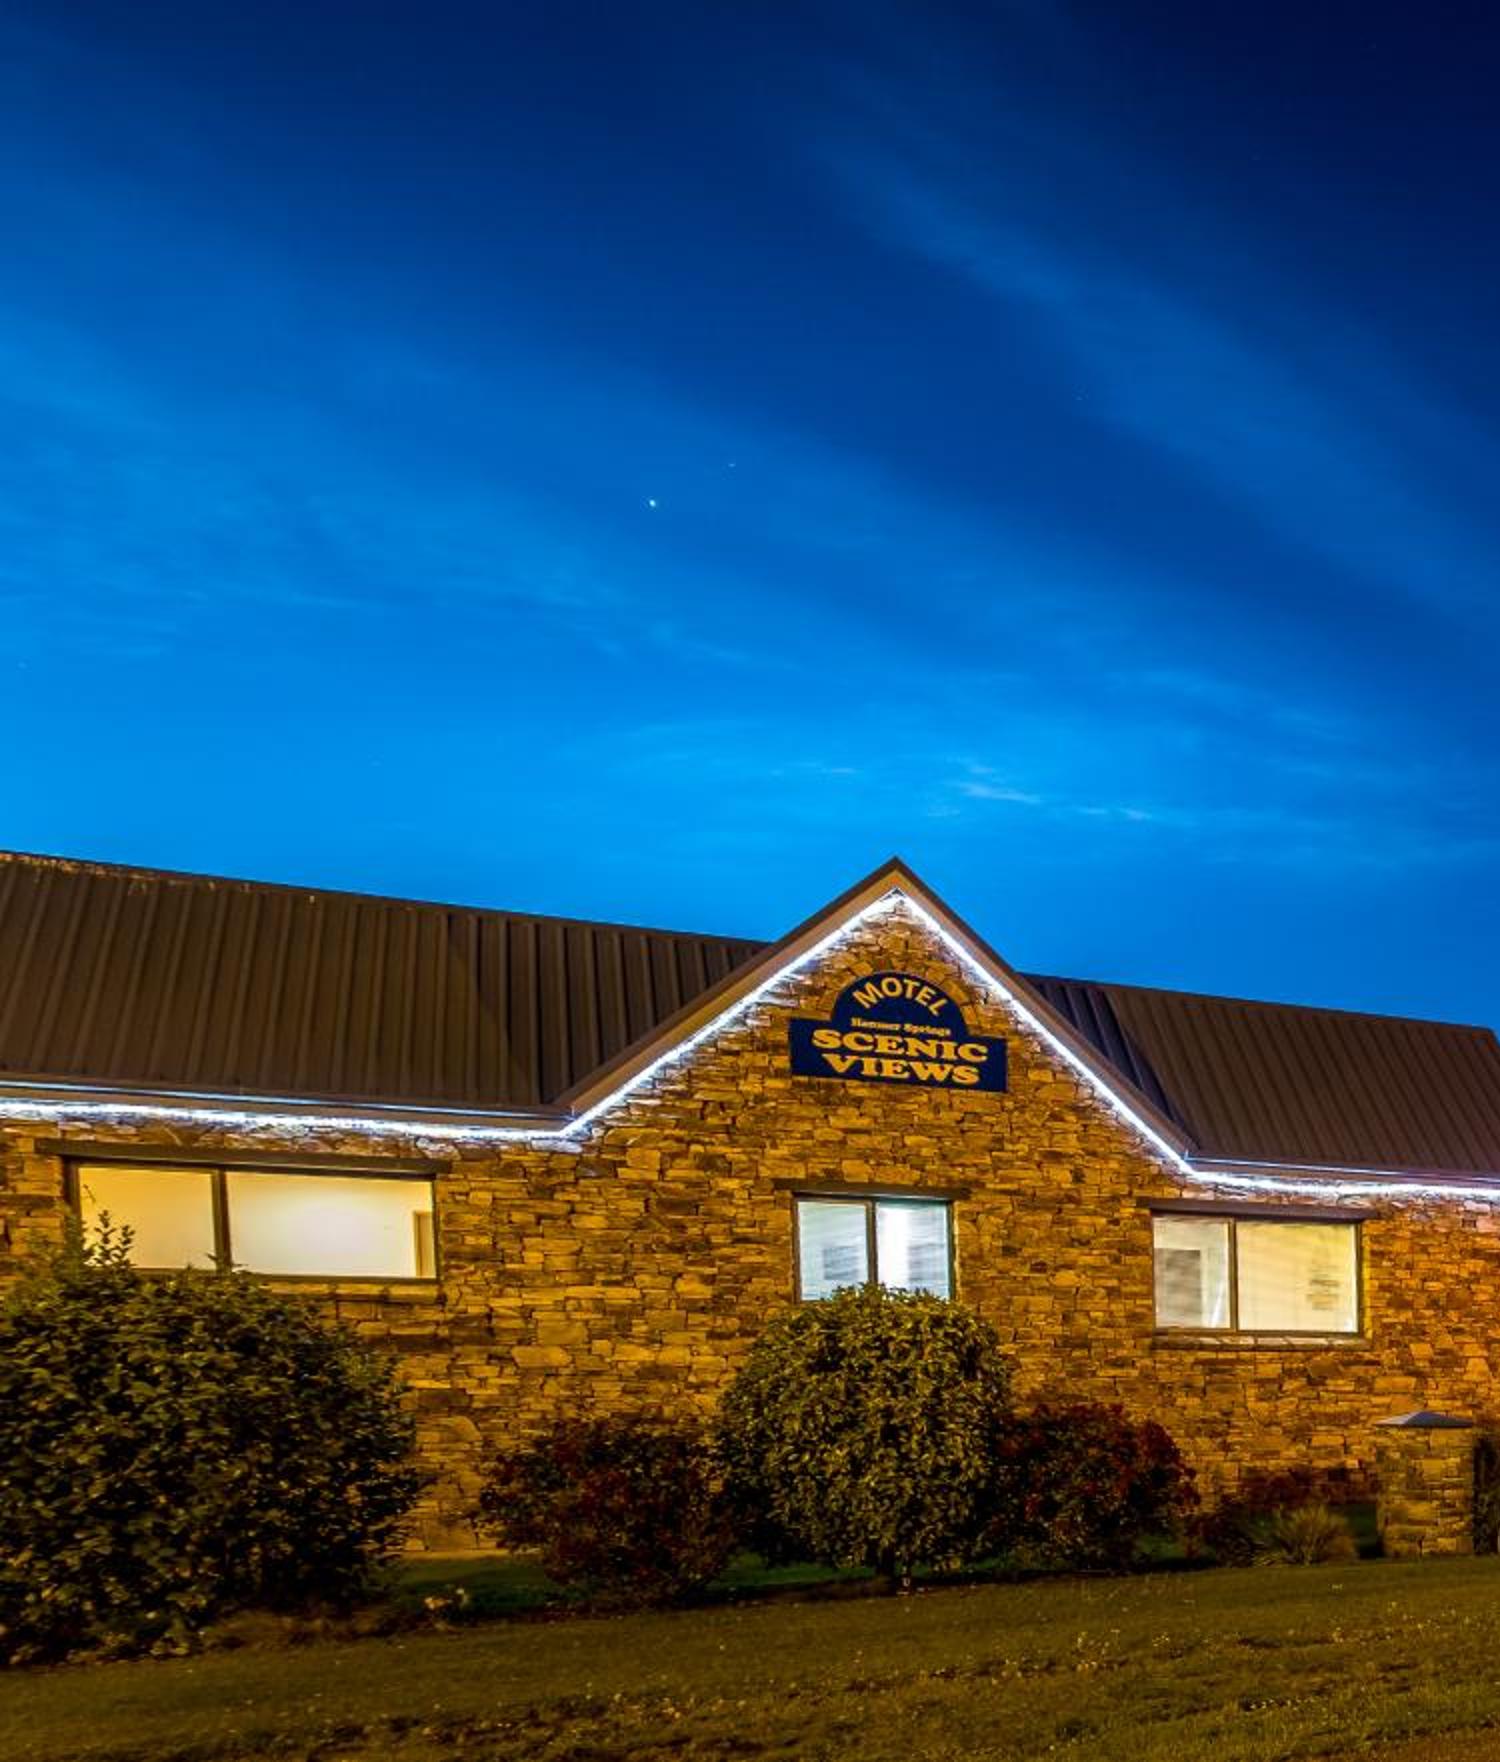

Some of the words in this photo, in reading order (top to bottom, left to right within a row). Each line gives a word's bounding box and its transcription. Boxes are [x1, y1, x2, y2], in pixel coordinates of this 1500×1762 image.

[852, 977, 948, 1016] MOTEL
[811, 1028, 989, 1063] SCENIC
[822, 1053, 980, 1085] VIEWS
